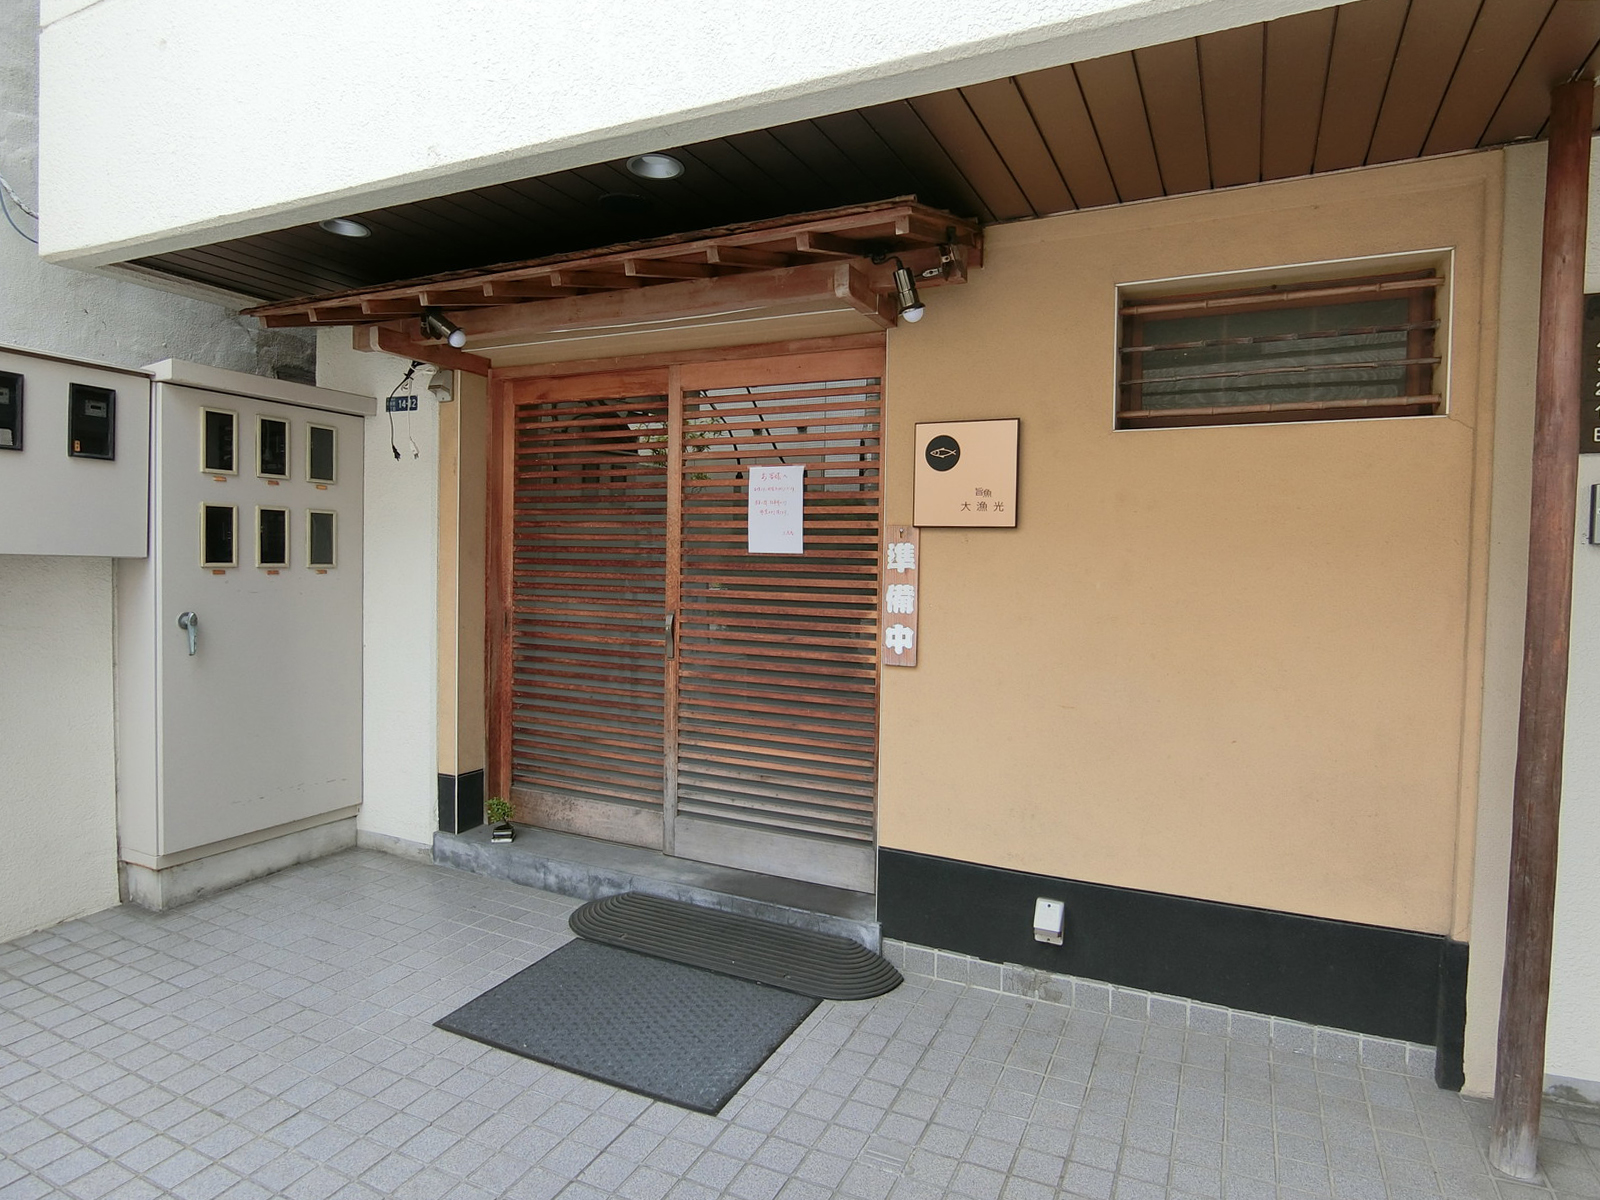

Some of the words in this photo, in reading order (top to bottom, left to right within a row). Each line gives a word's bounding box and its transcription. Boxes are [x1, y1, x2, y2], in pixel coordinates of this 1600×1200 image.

[960, 501, 1005, 512] 大漁光
[885, 542, 916, 655] 準備中
